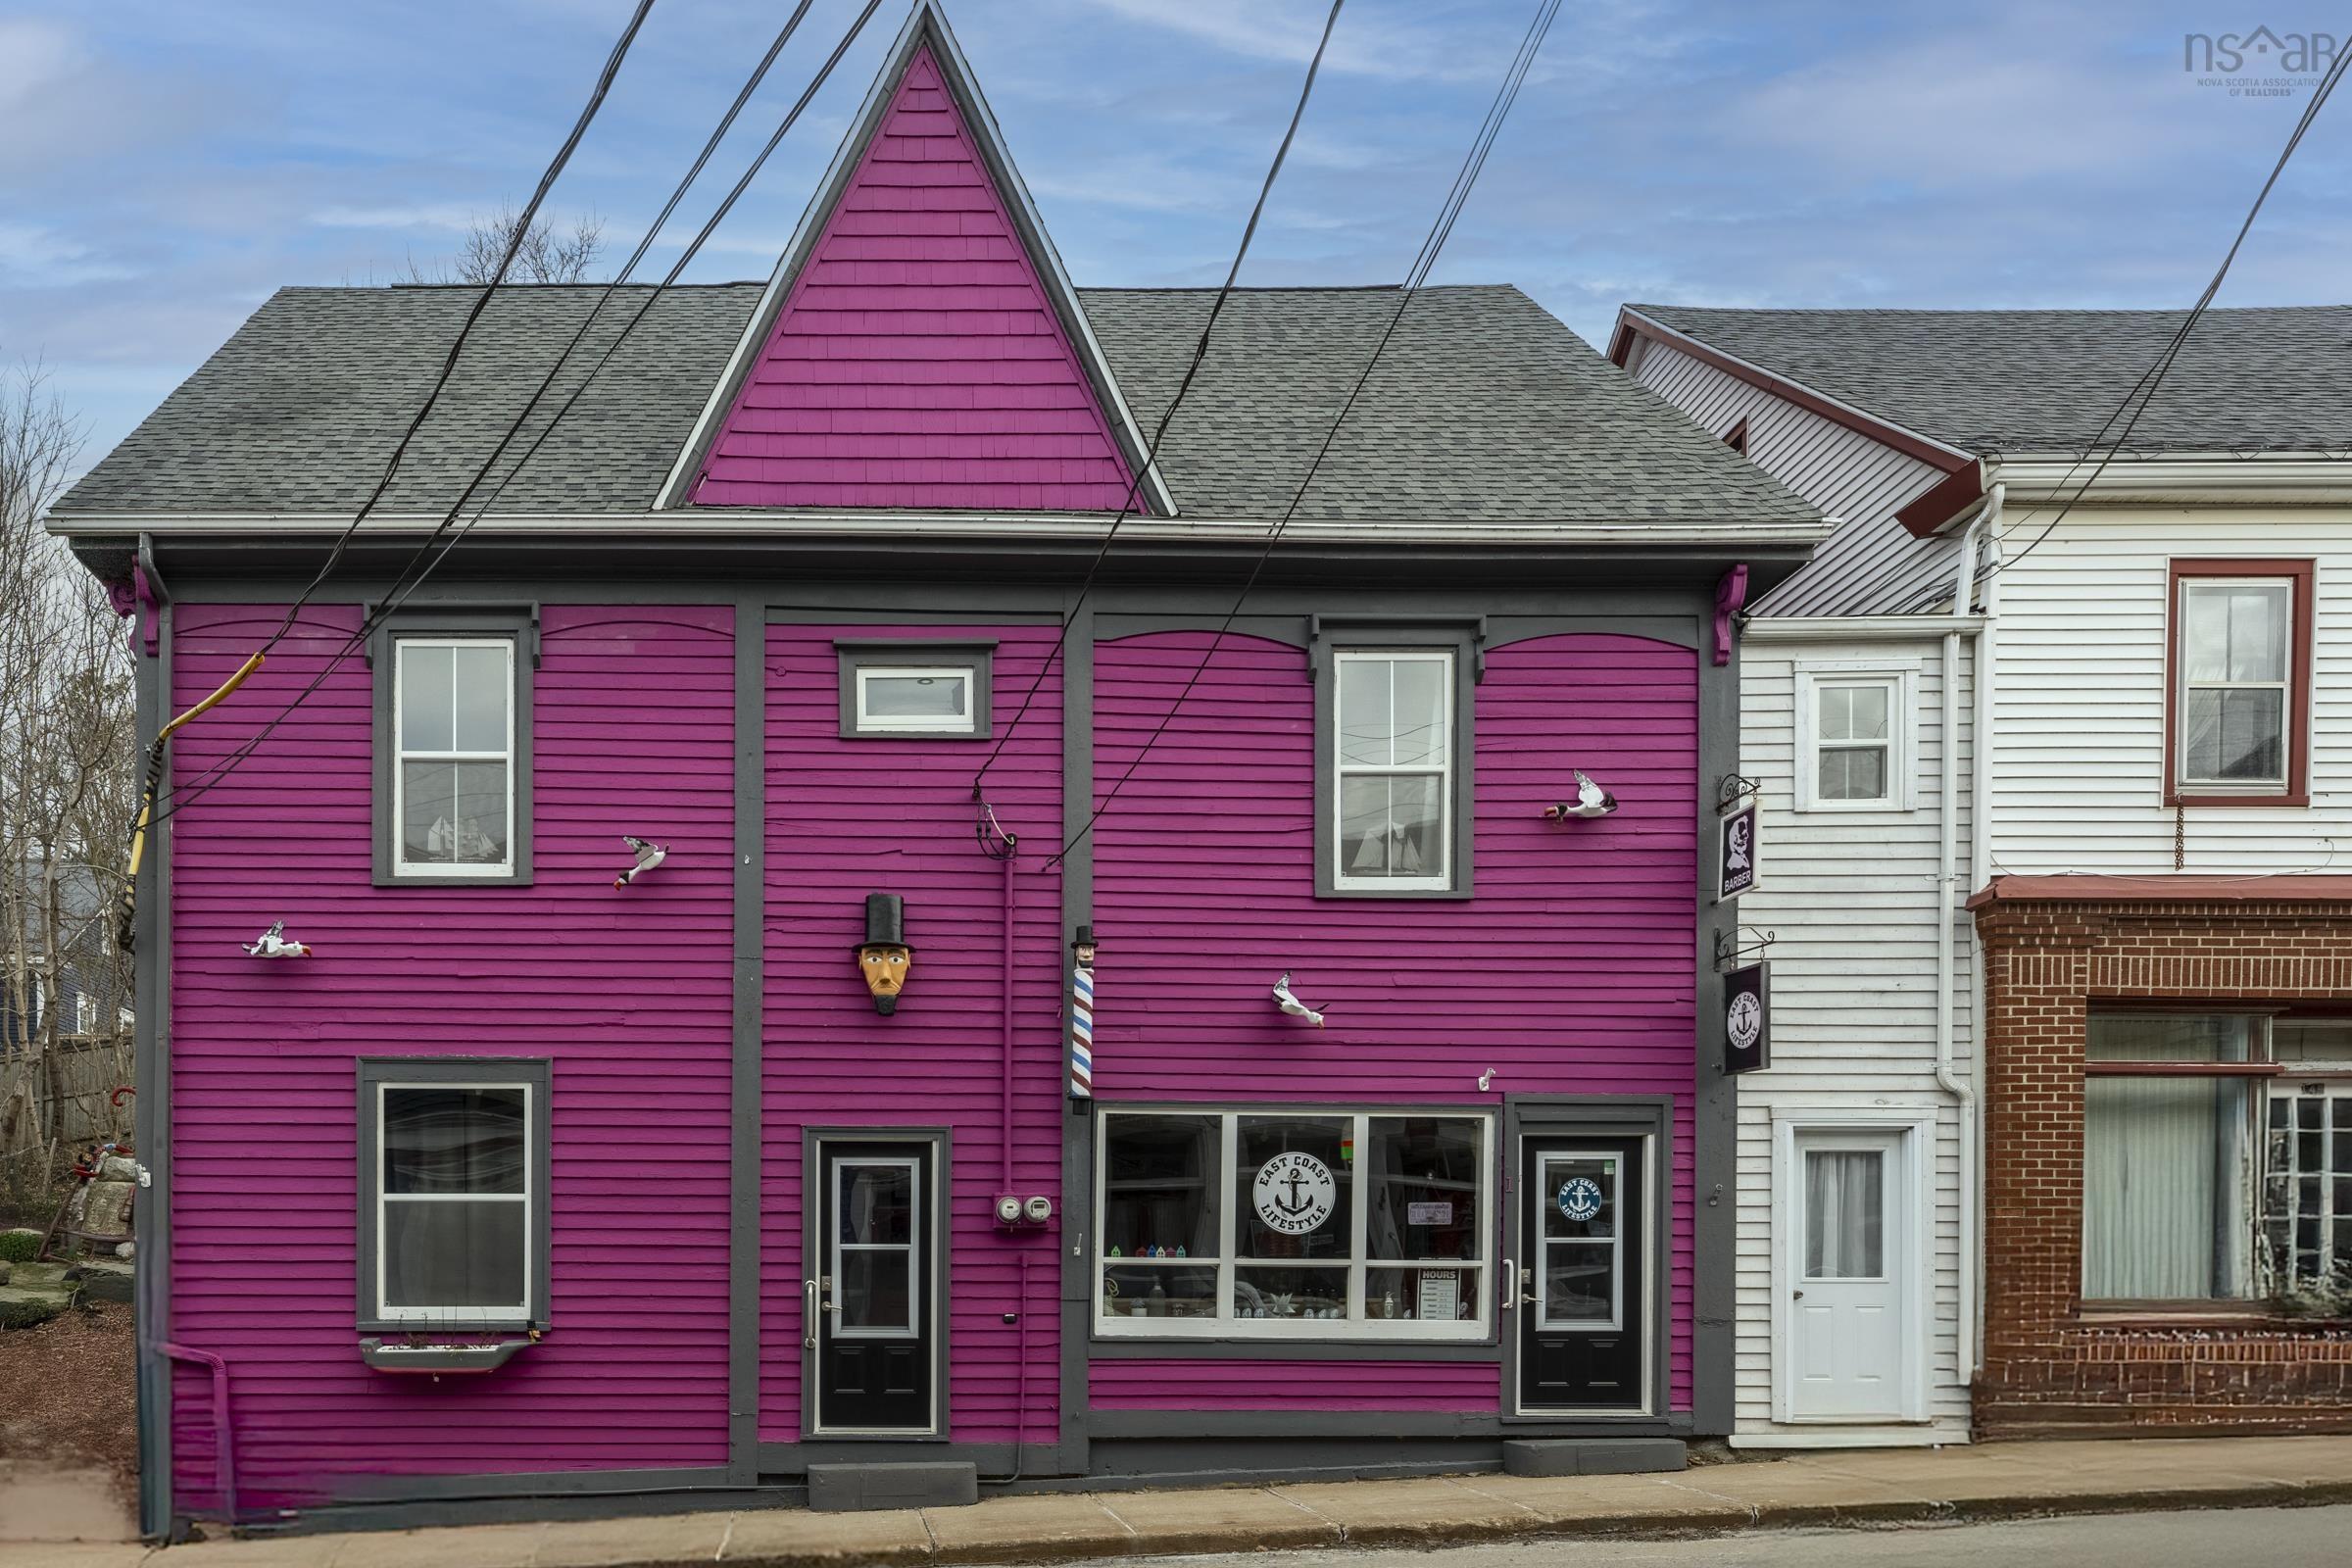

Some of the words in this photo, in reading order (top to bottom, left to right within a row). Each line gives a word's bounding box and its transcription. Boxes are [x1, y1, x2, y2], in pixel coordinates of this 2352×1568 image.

[1725, 870, 1751, 892] BARBER
[1730, 997, 1741, 1018] EAST
[1743, 995, 1759, 1011] COAST
[1731, 1026, 1758, 1046] LIFESTYLE
[1259, 1156, 1288, 1187] EAST
[1294, 1155, 1331, 1186] COAST
[1561, 1180, 1578, 1196] EAST
[1579, 1179, 1599, 1196] COAST
[1261, 1203, 1327, 1230] LIFESTYLE
[1562, 1204, 1597, 1219] LIFESTYLE
[1422, 1270, 1456, 1279] HOURS
